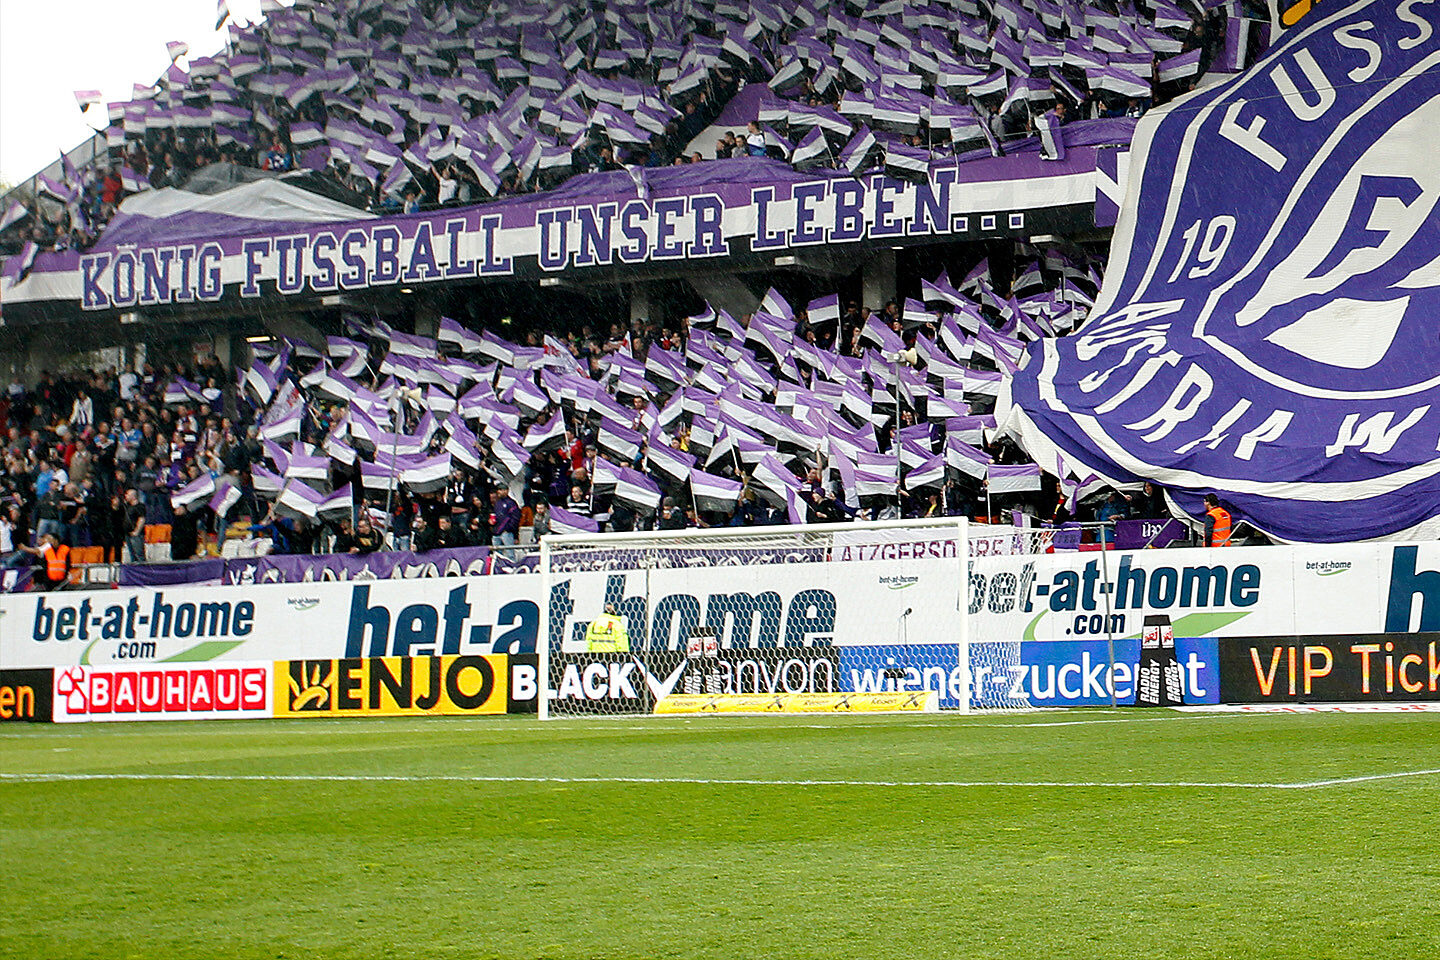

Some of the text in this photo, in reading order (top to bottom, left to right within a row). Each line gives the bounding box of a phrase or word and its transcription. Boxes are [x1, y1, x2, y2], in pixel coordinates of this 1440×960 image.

[80, 243, 223, 311] KÖNIG
[240, 214, 514, 298] FUSSBALL
[535, 192, 729, 273] UNSER
[1168, 214, 1236, 284] 19
[957, 554, 1261, 615] bet-at-home
[32, 592, 255, 641] bet-at-home
[112, 641, 156, 659] .com
[1248, 646, 1333, 696] VIP
[90, 671, 264, 709] BAUHAUS
[338, 655, 495, 711] ENJO
[1140, 667, 1151, 702] RADIO
[1149, 658, 1160, 705] ENERGY
